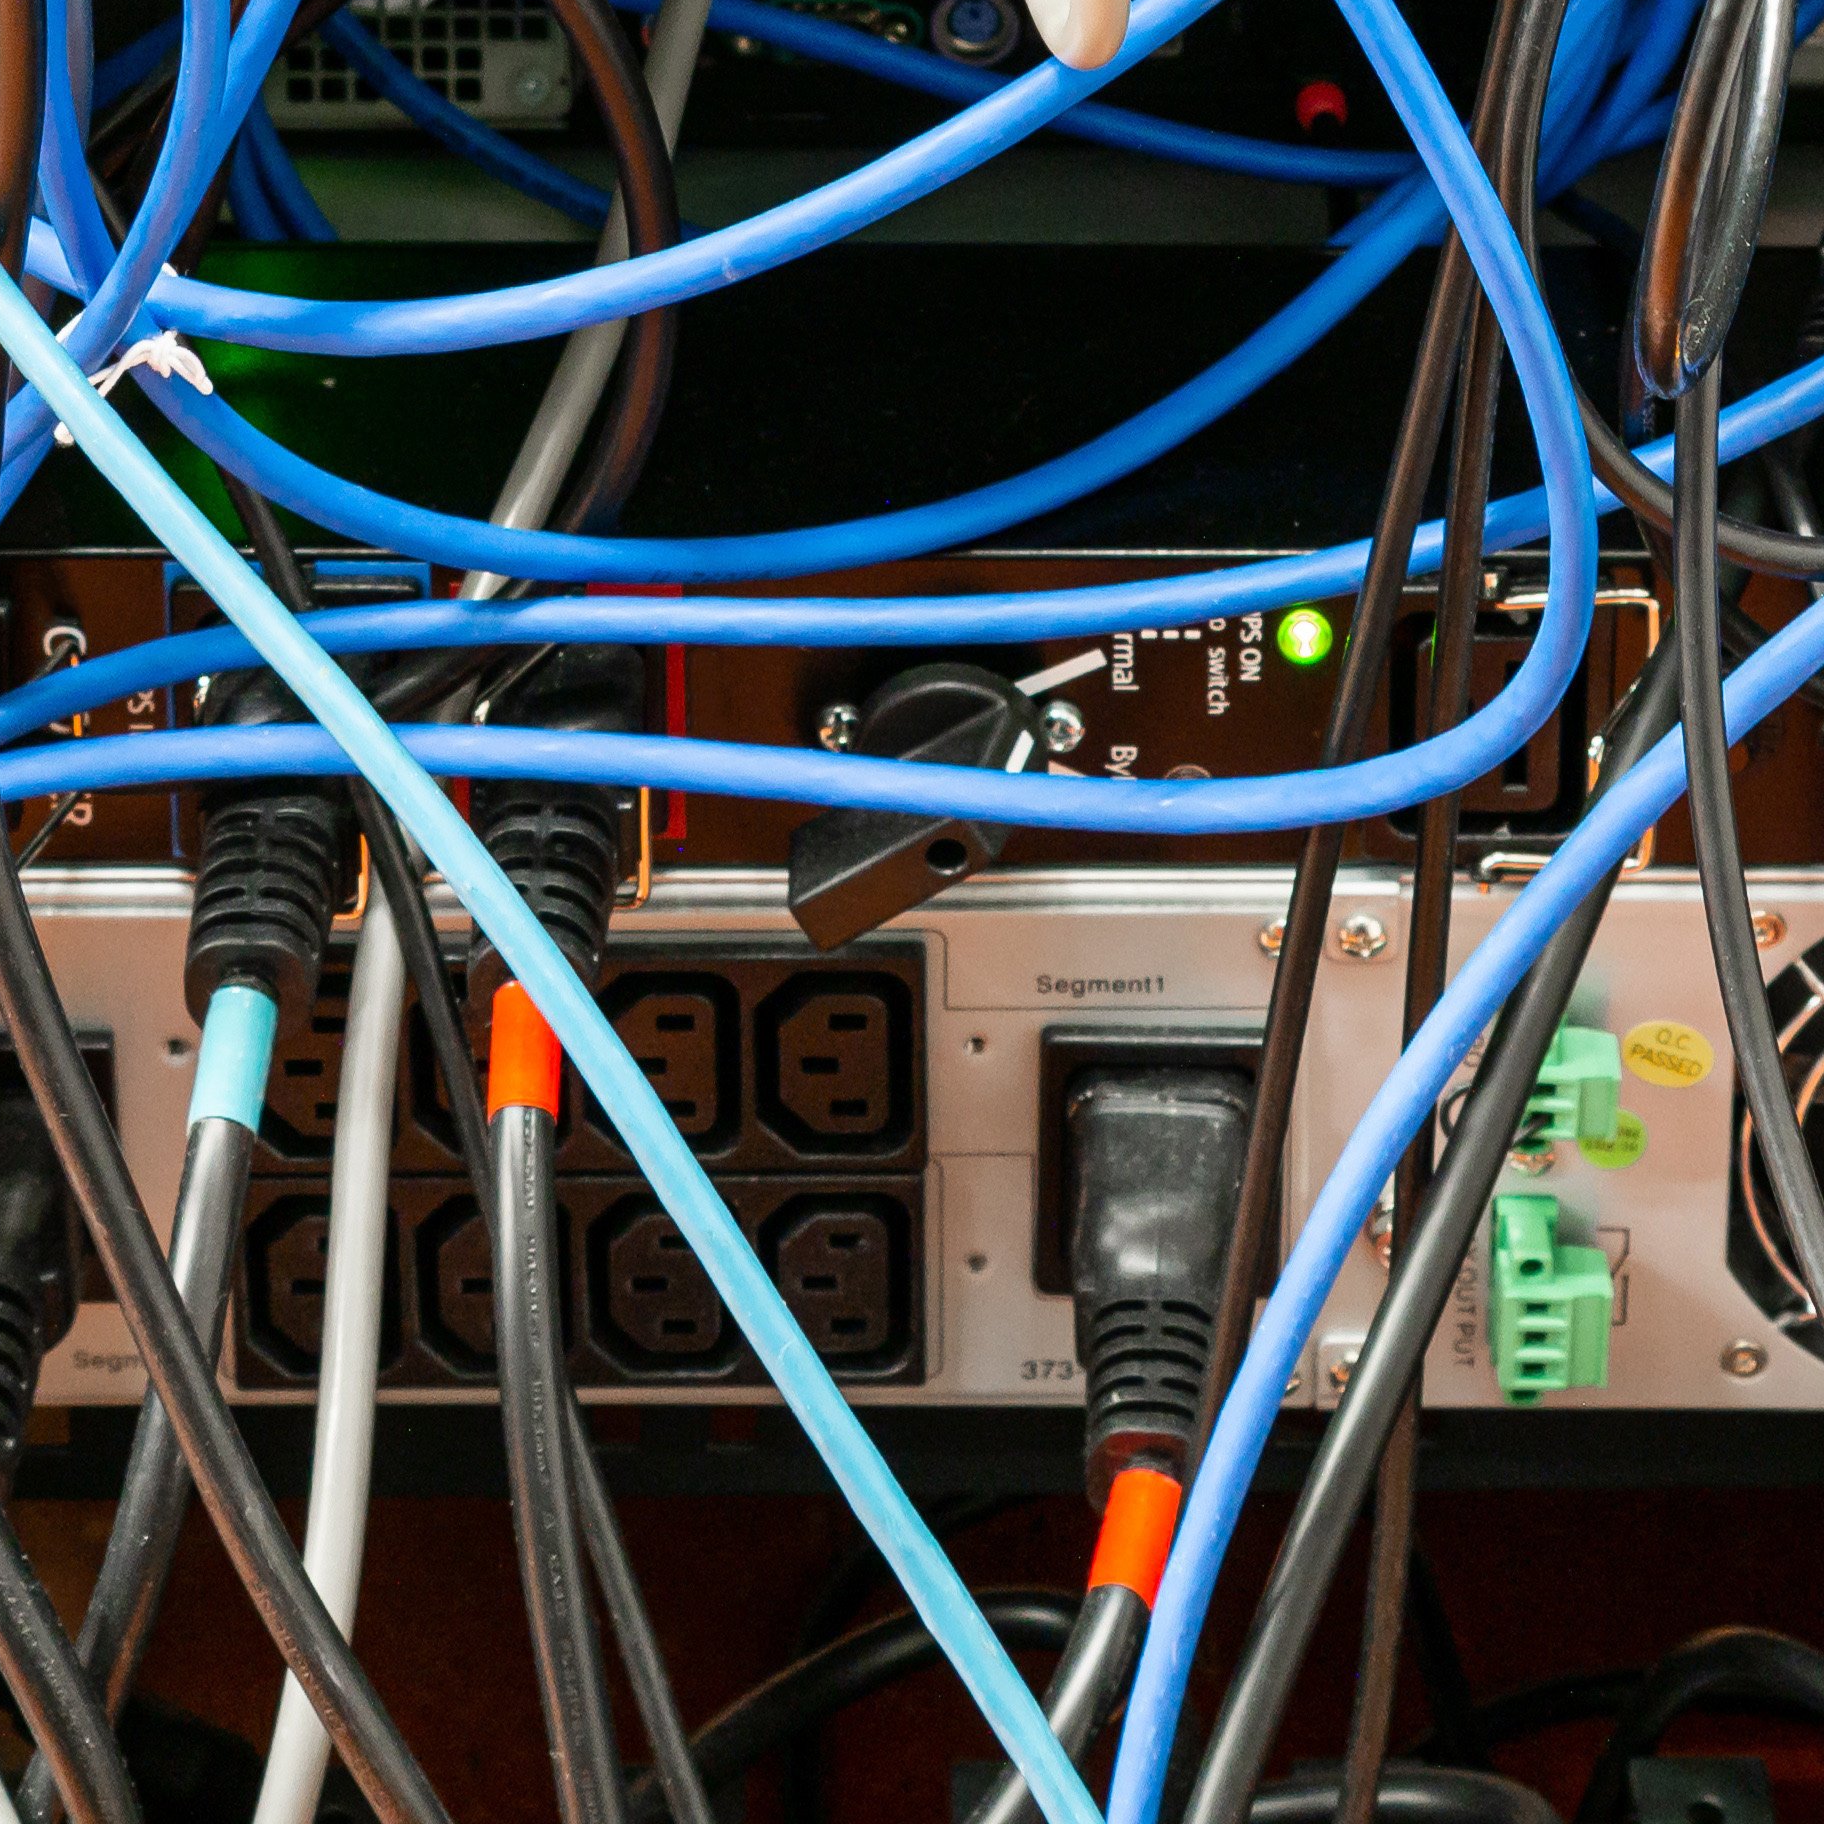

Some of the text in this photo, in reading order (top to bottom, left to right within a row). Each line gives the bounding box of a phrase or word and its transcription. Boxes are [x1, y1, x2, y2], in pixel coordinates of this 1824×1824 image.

[1207, 647, 1230, 715] switch
[1239, 648, 1262, 681] ON
[1630, 1042, 1704, 1078] PASSED
